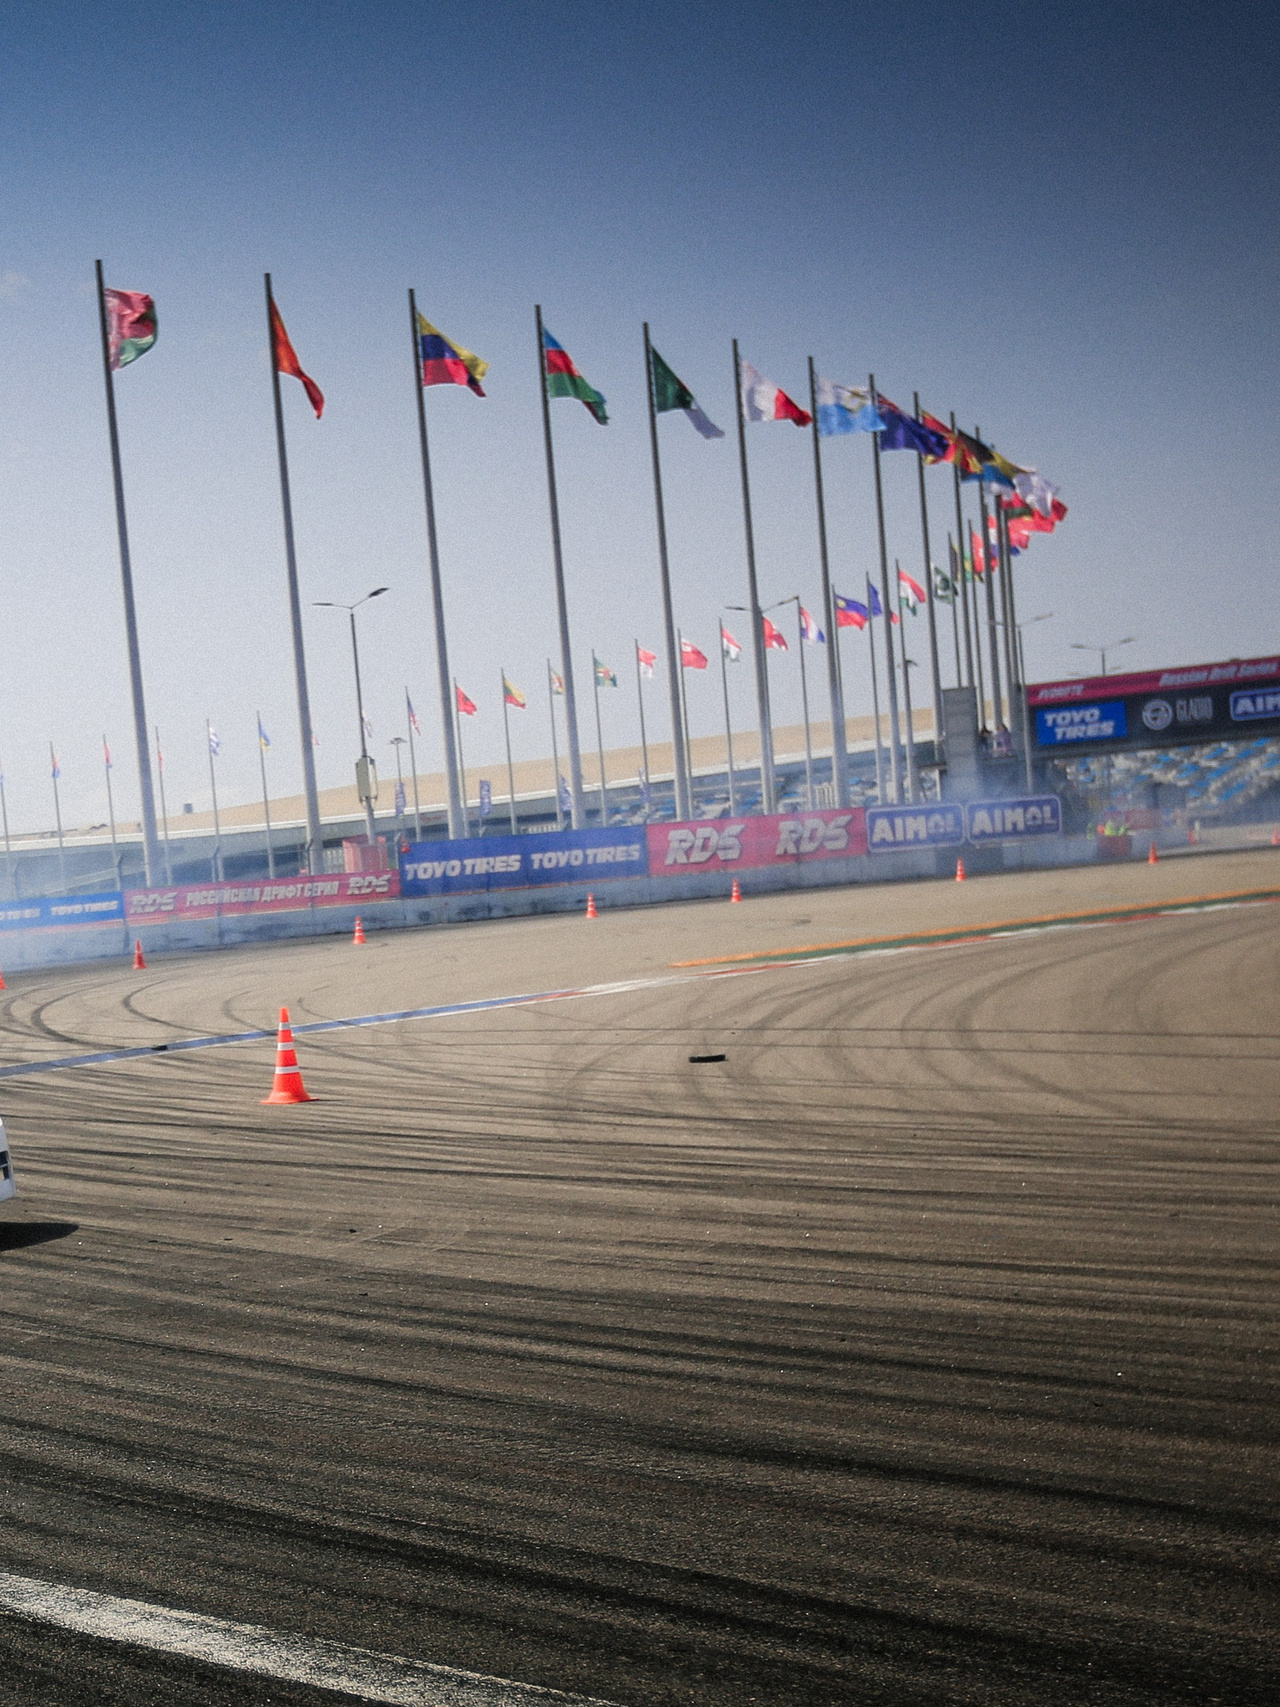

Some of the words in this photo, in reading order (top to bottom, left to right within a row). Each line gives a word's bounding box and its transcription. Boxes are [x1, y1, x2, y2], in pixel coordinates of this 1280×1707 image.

[1044, 707, 1100, 727] TOYO
[1054, 720, 1115, 740] TIRES
[665, 824, 746, 866] RDS
[776, 816, 853, 856] RDS
[405, 860, 462, 880] TOYO
[462, 855, 521, 875] TIRES
[531, 849, 584, 870] TOYO
[585, 844, 641, 864] TIRES
[347, 874, 392, 895] RDS
[130, 892, 179, 914] RDS
